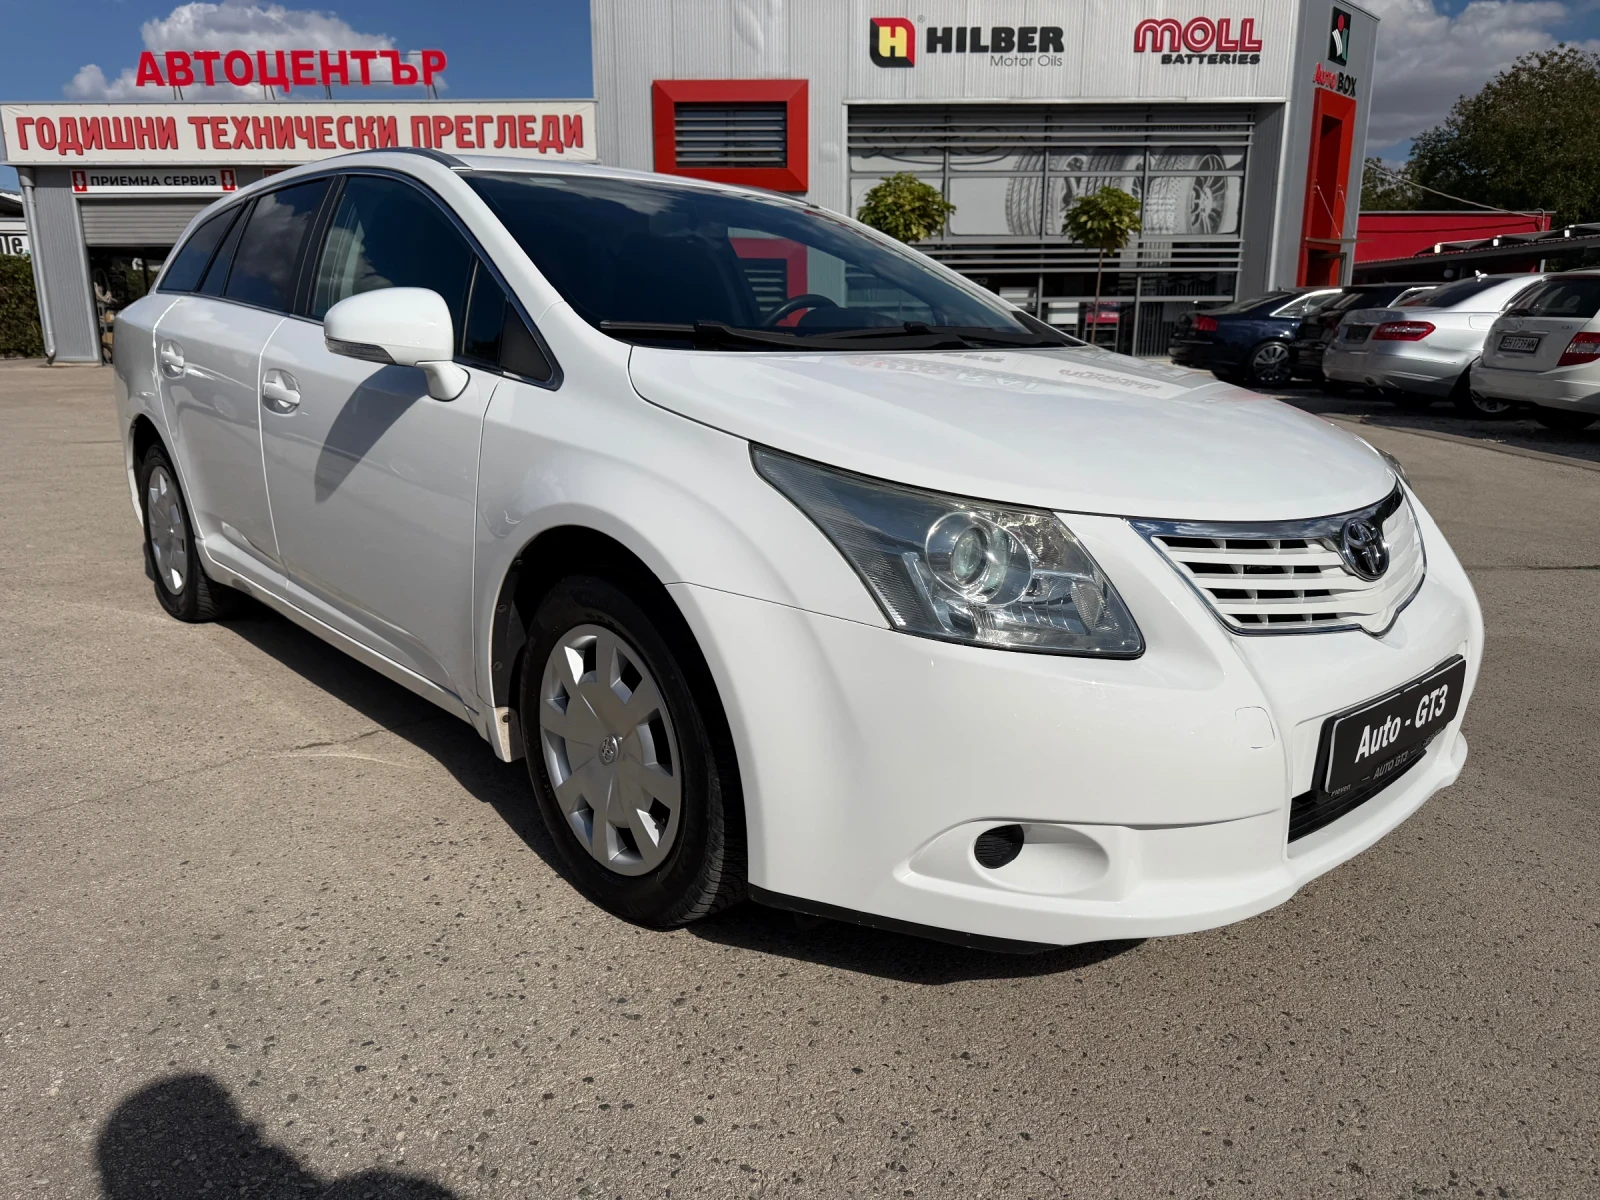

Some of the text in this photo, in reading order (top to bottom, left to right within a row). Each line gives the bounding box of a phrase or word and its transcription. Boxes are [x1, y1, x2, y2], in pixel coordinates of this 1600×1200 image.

[926, 26, 1065, 53] HILBER
[135, 50, 447, 92] АВТОЦЕНТЪР
[990, 54, 1063, 67] Motor Oils
[1161, 53, 1261, 65] BATTERIES
[1337, 71, 1357, 97] BOX
[16, 114, 584, 156] ГОДИШНИ ТЕХНИЧЕСКИ ПРЕГЛЕДИ
[89, 175, 218, 187] ПРИЕМНА СЕРВИЗ
[1354, 714, 1401, 764] Auto
[1415, 683, 1449, 728] GT3
[1373, 759, 1395, 780] AUTO
